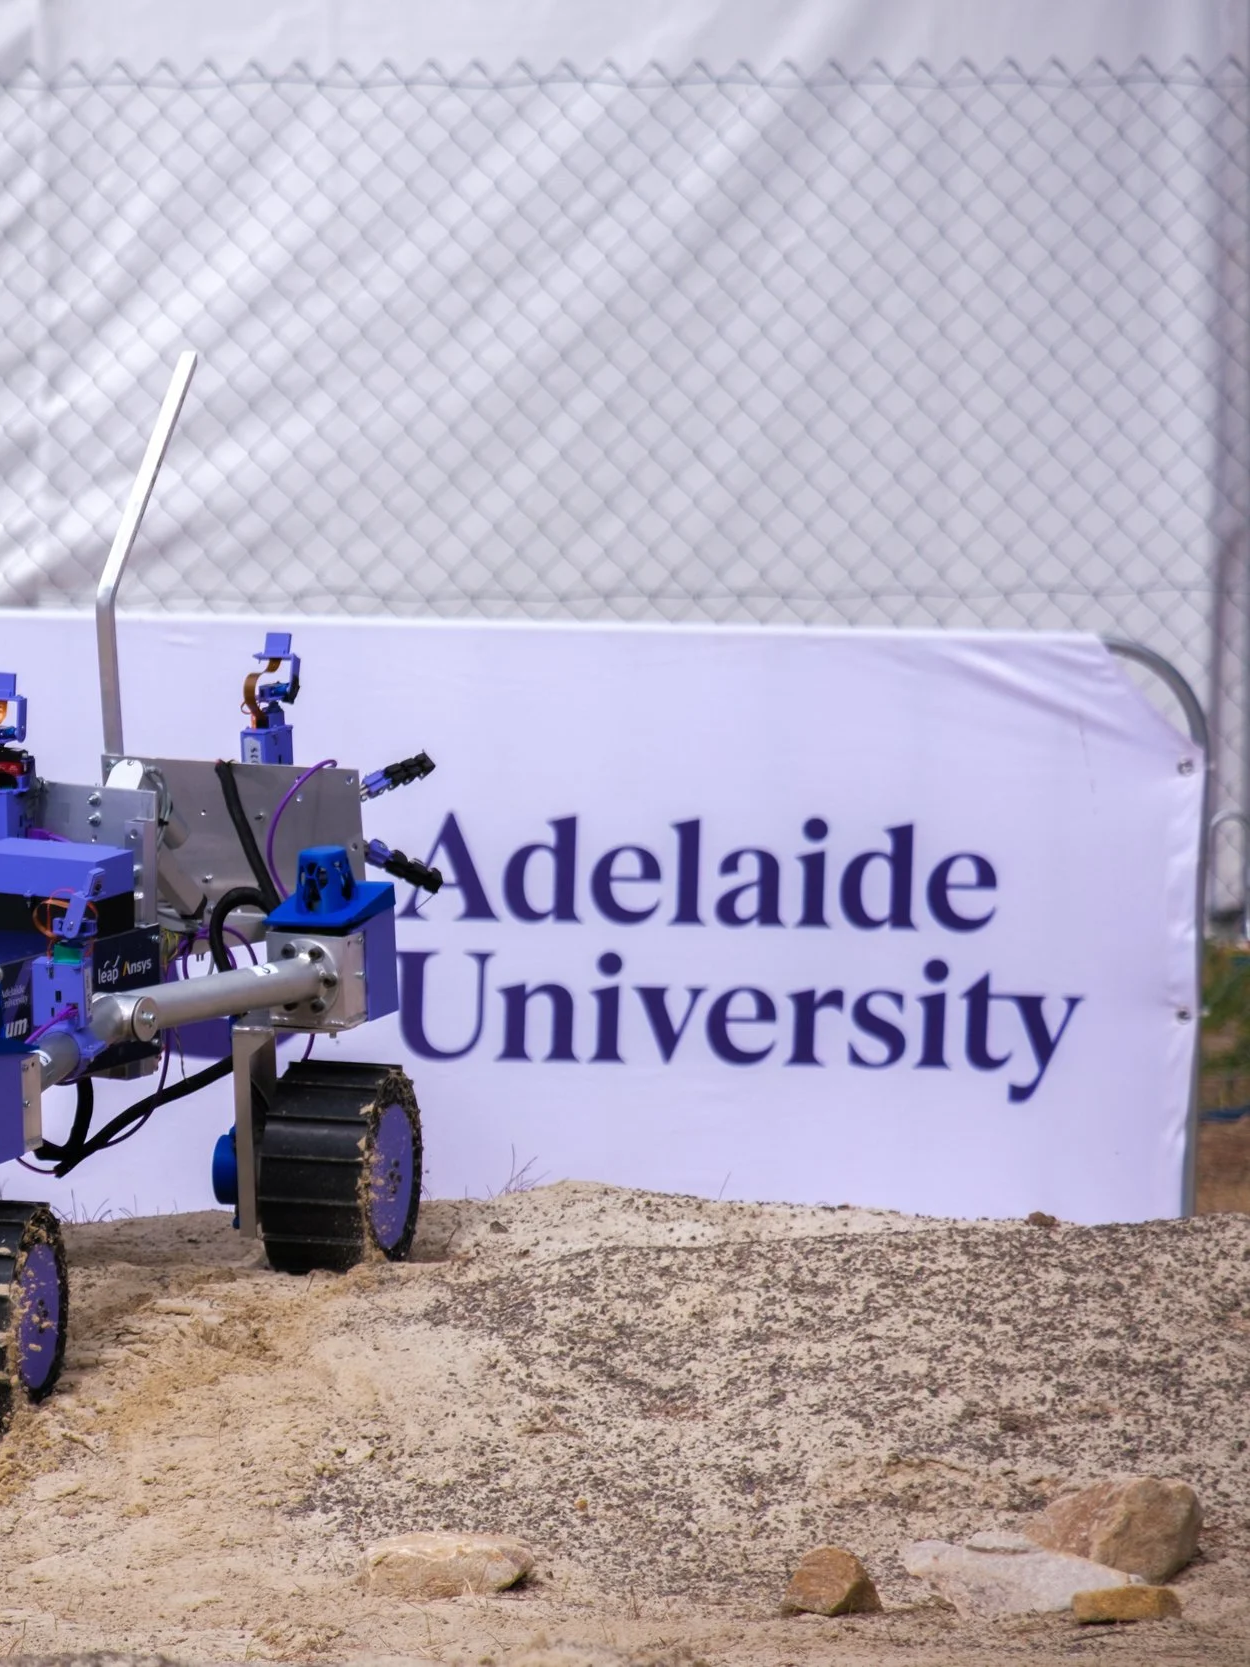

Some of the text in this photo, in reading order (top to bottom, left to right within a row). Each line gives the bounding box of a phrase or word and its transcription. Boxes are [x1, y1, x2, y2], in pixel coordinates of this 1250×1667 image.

[397, 811, 998, 933] Adelaide
[123, 958, 152, 976] Ansys
[397, 951, 1085, 1104] University
